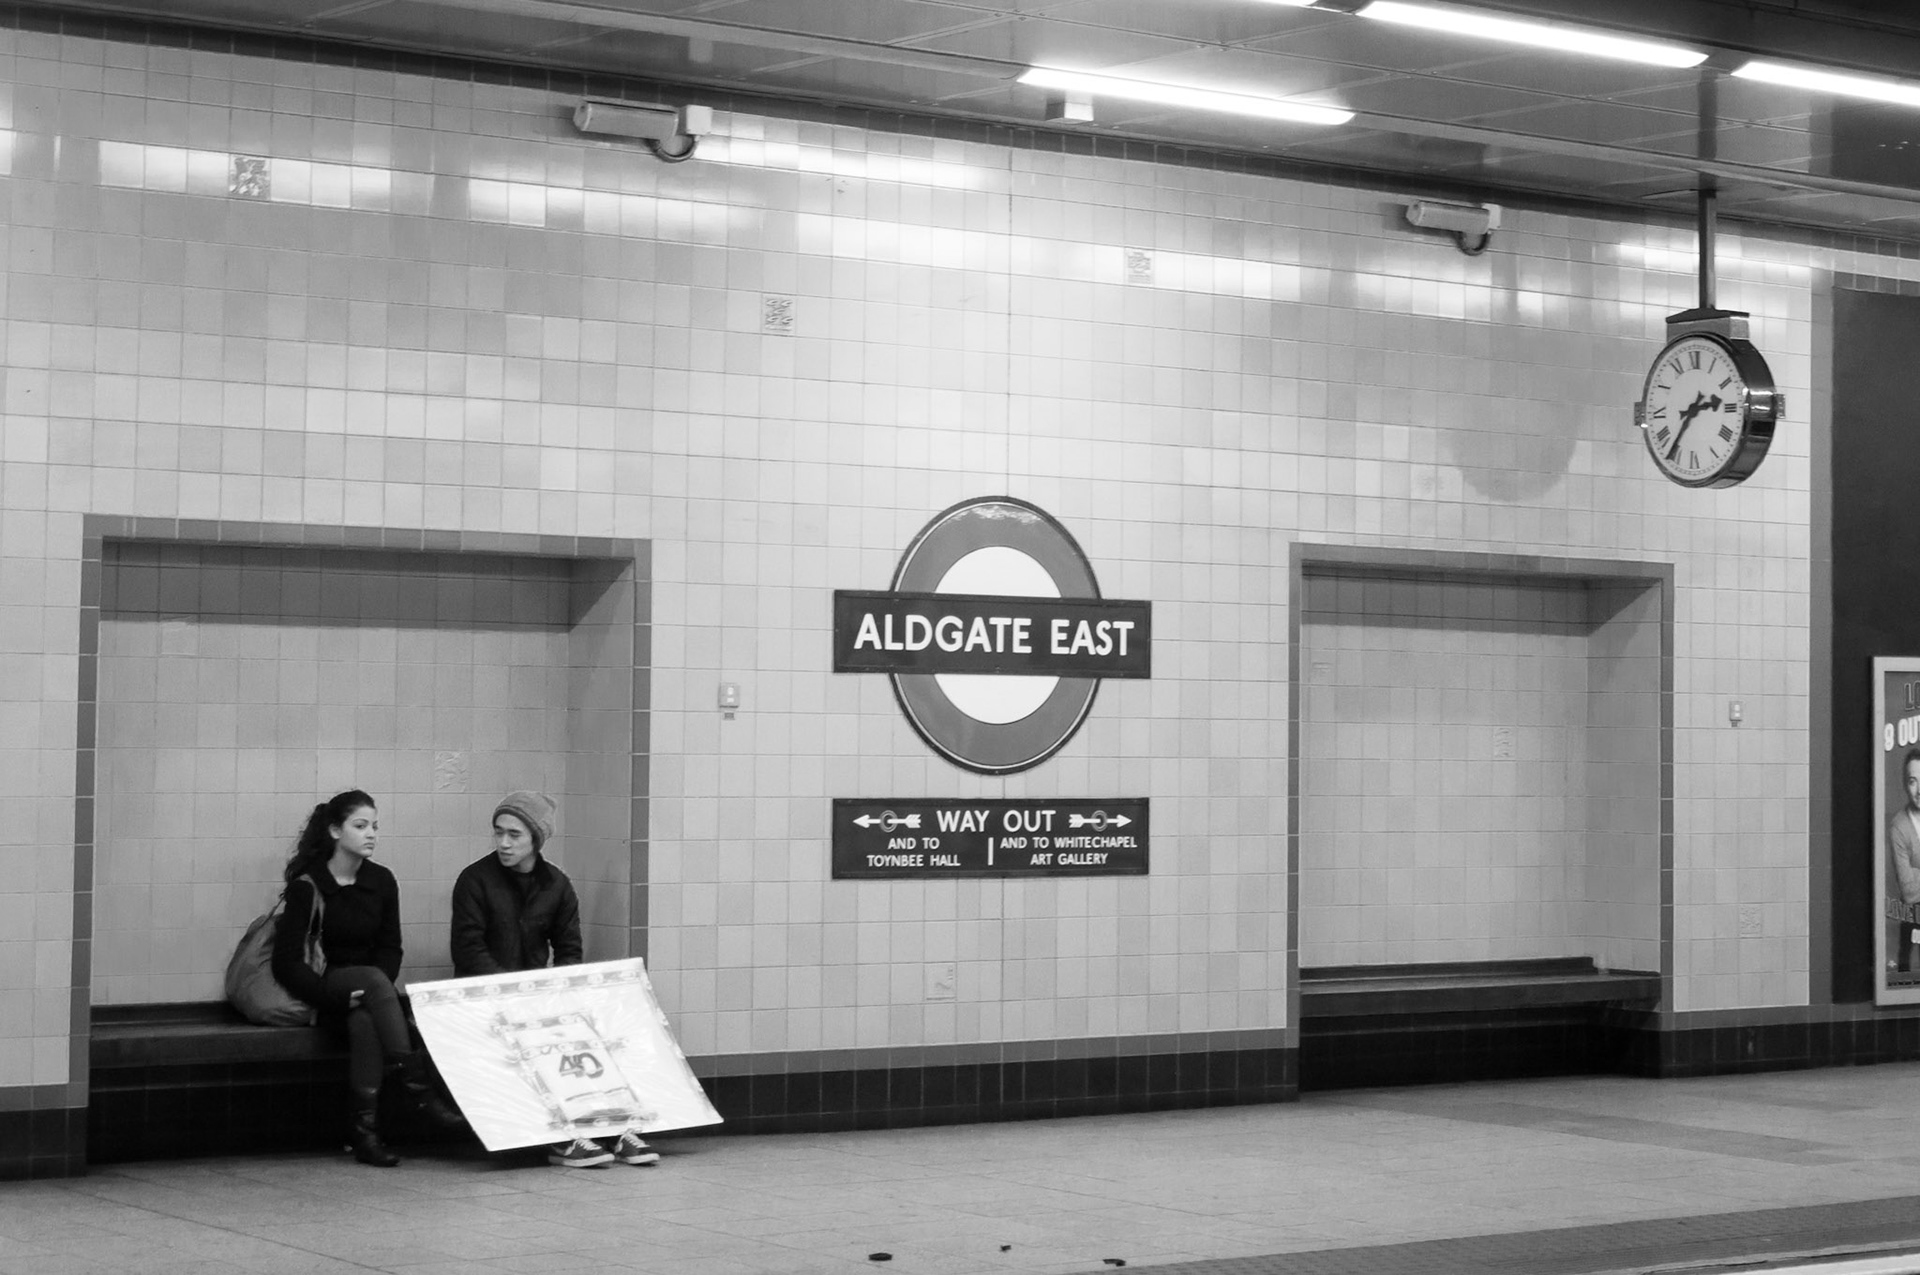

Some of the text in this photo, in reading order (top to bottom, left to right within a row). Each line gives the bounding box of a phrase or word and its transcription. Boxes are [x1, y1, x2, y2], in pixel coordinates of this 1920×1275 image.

[853, 613, 1135, 656] ALDGATE EAST
[936, 809, 1057, 833] WAY OUT
[887, 837, 940, 850] AND TO
[1000, 836, 1138, 849] AND TO WHITECHAPEL
[866, 854, 961, 867] TOYNBEE HALL
[1030, 852, 1109, 866] ART GALLERY
